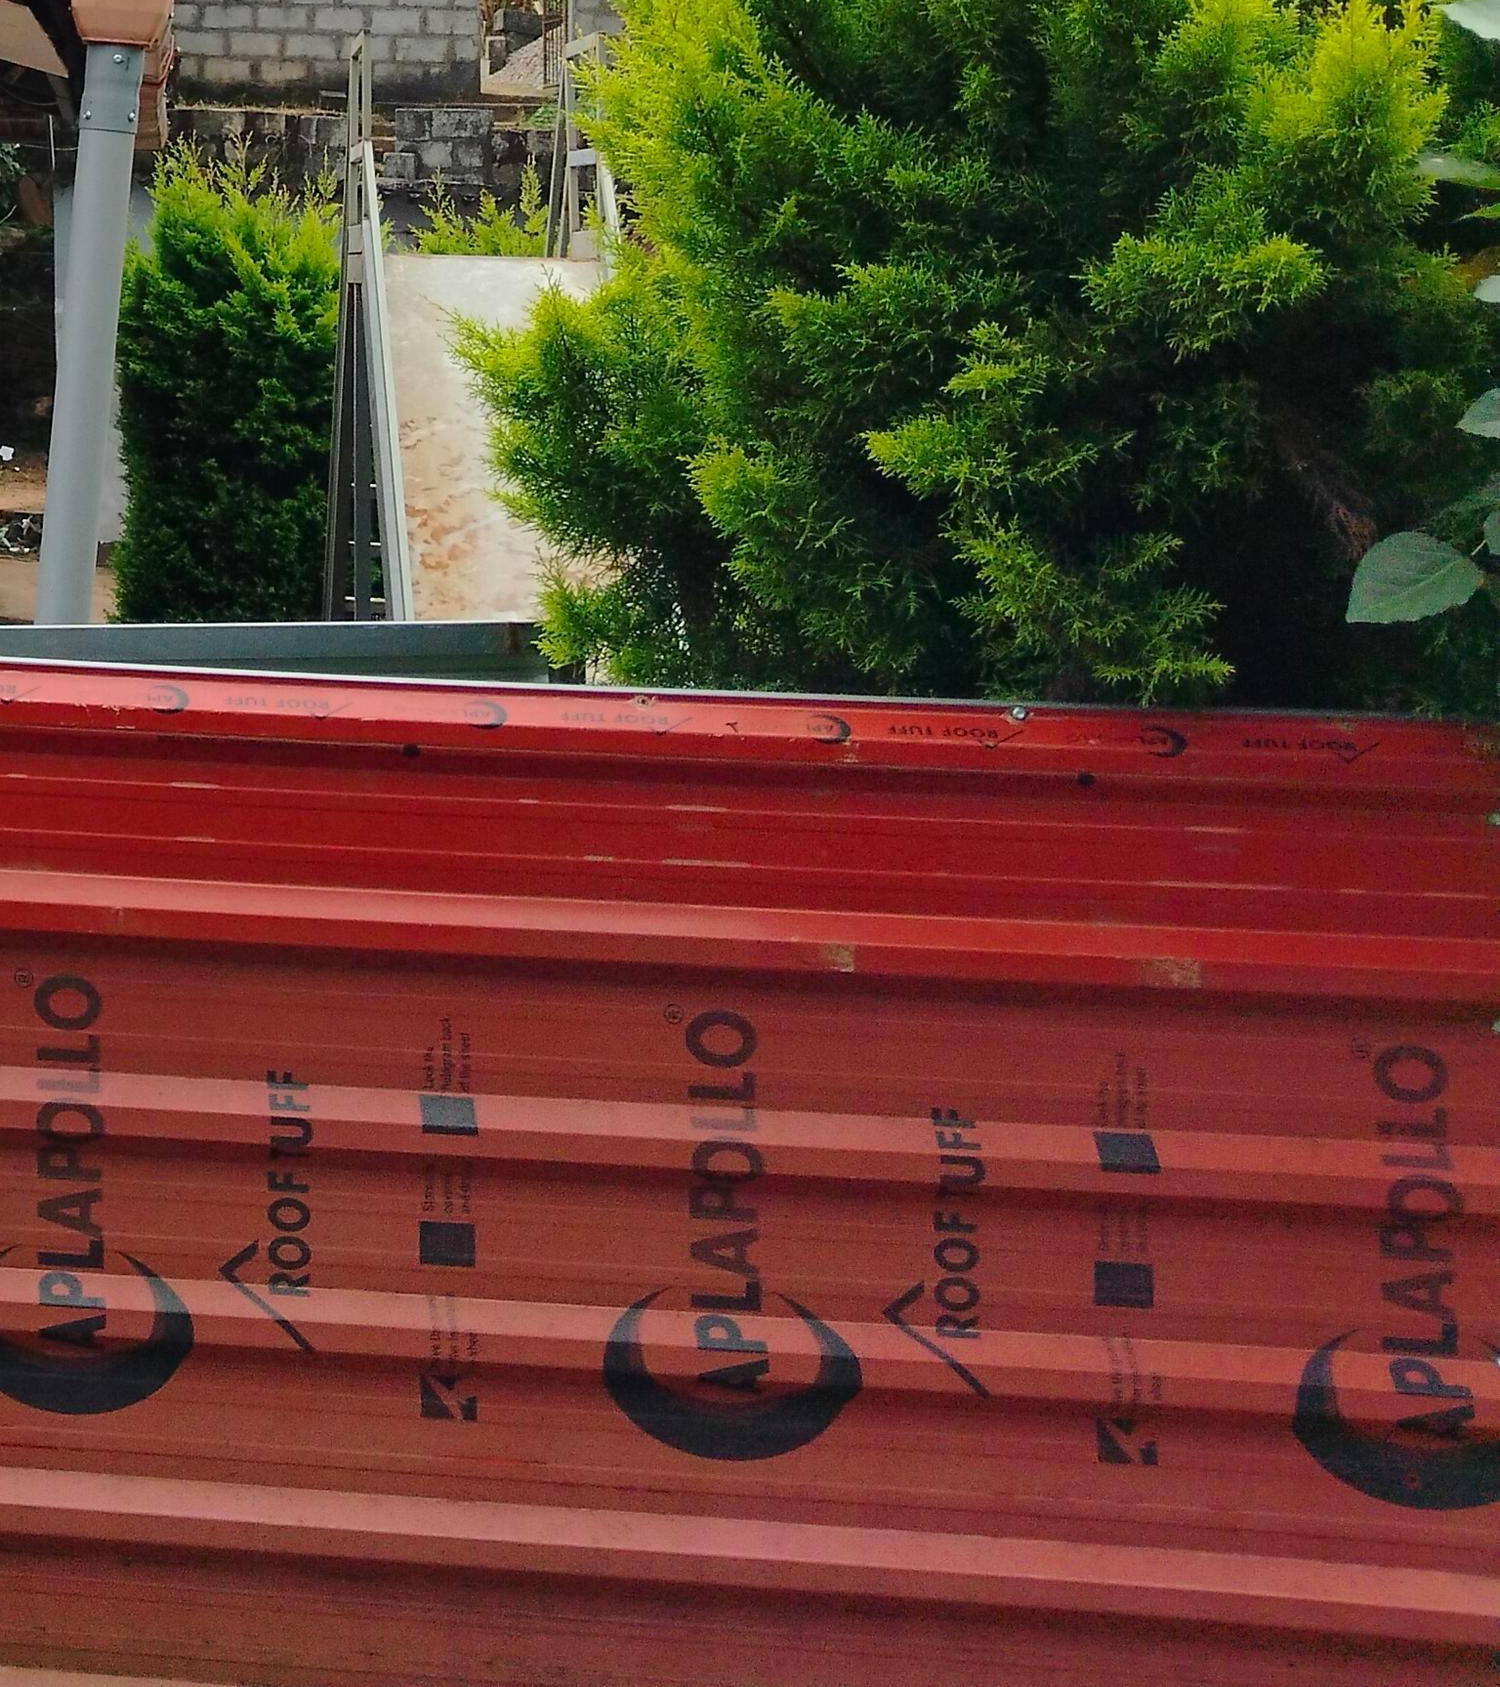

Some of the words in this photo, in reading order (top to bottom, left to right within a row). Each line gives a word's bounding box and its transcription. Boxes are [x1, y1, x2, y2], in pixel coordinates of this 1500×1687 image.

[224, 696, 268, 707] TUFF
[275, 698, 329, 709] ROOF
[560, 712, 607, 723] TUFF
[614, 714, 670, 726] ROOF
[887, 725, 933, 736] TUFF
[941, 726, 1000, 739] ROOF
[267, 1069, 313, 1162] TUFF
[931, 1106, 986, 1200] TUFF
[268, 1172, 313, 1298] ROOF
[934, 1210, 982, 1340] ROOF
